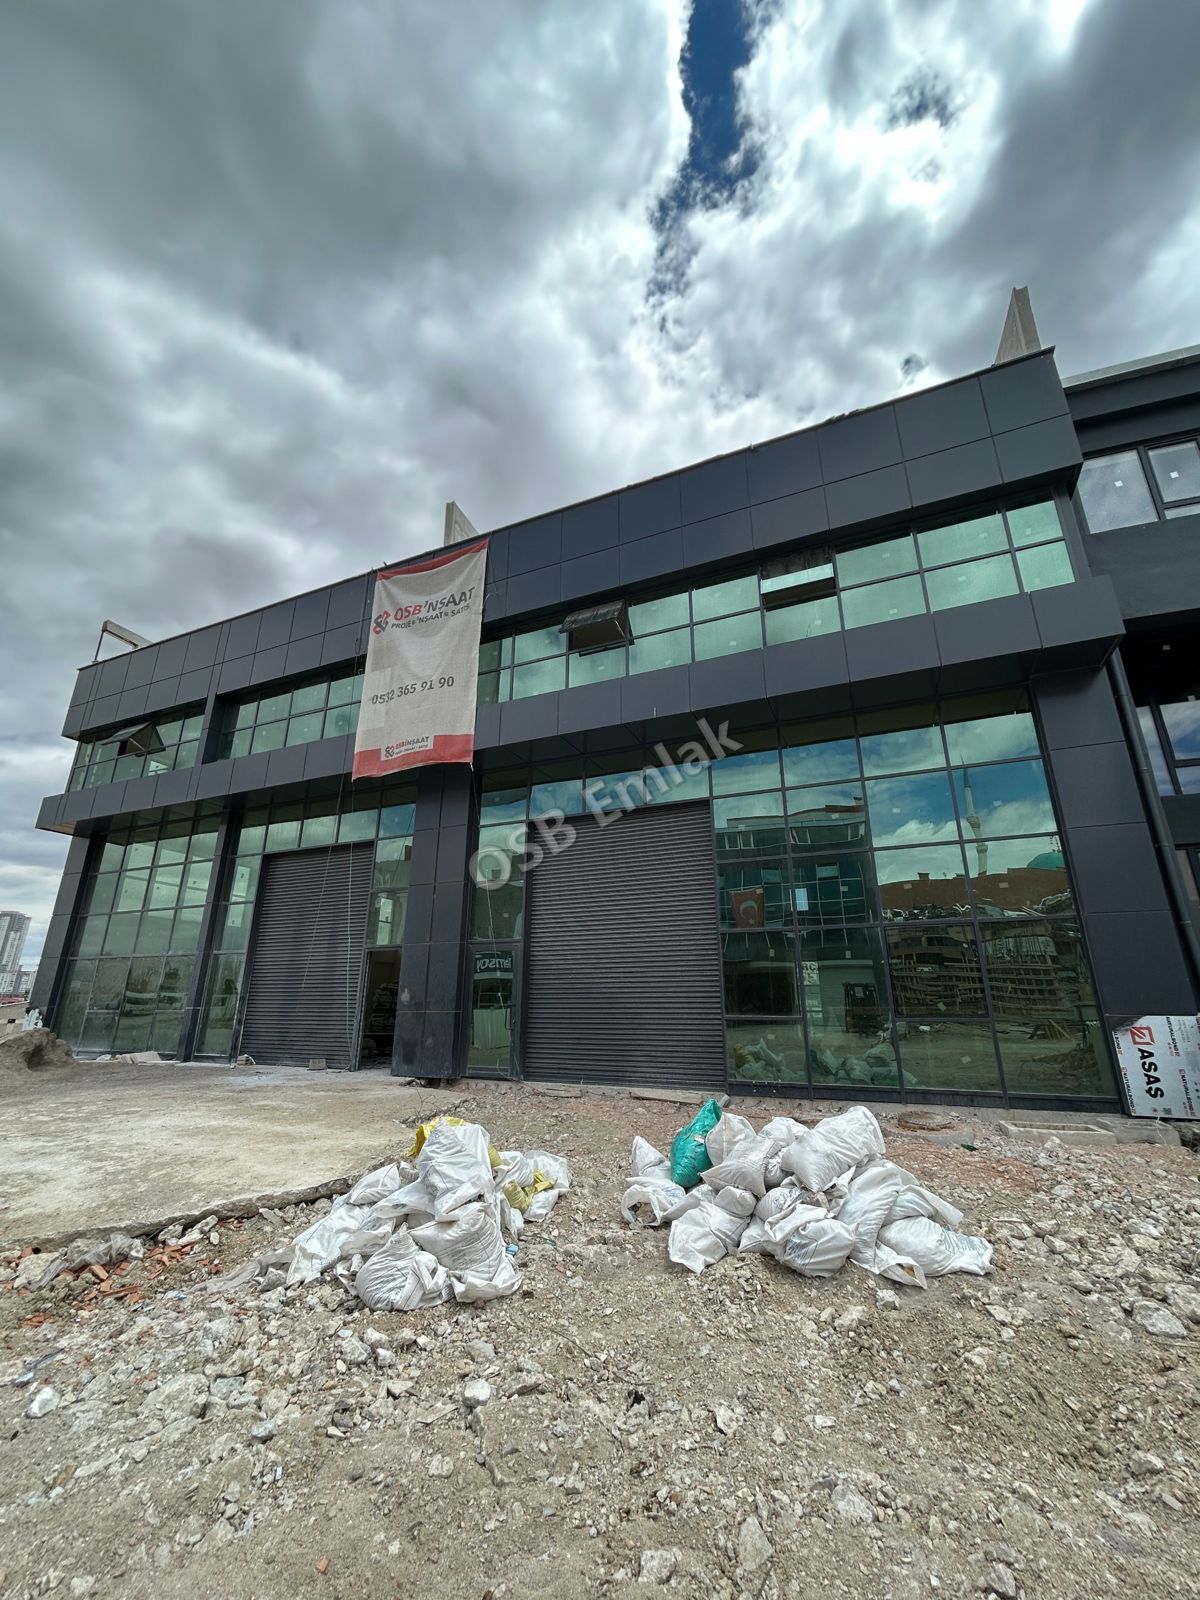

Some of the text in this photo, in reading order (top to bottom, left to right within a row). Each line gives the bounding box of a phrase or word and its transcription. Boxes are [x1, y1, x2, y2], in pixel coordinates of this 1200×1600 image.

[397, 683, 417, 698] 365
[420, 679, 435, 692] 91
[438, 676, 455, 689] 90
[1138, 1048, 1165, 1099] ASAŞ
